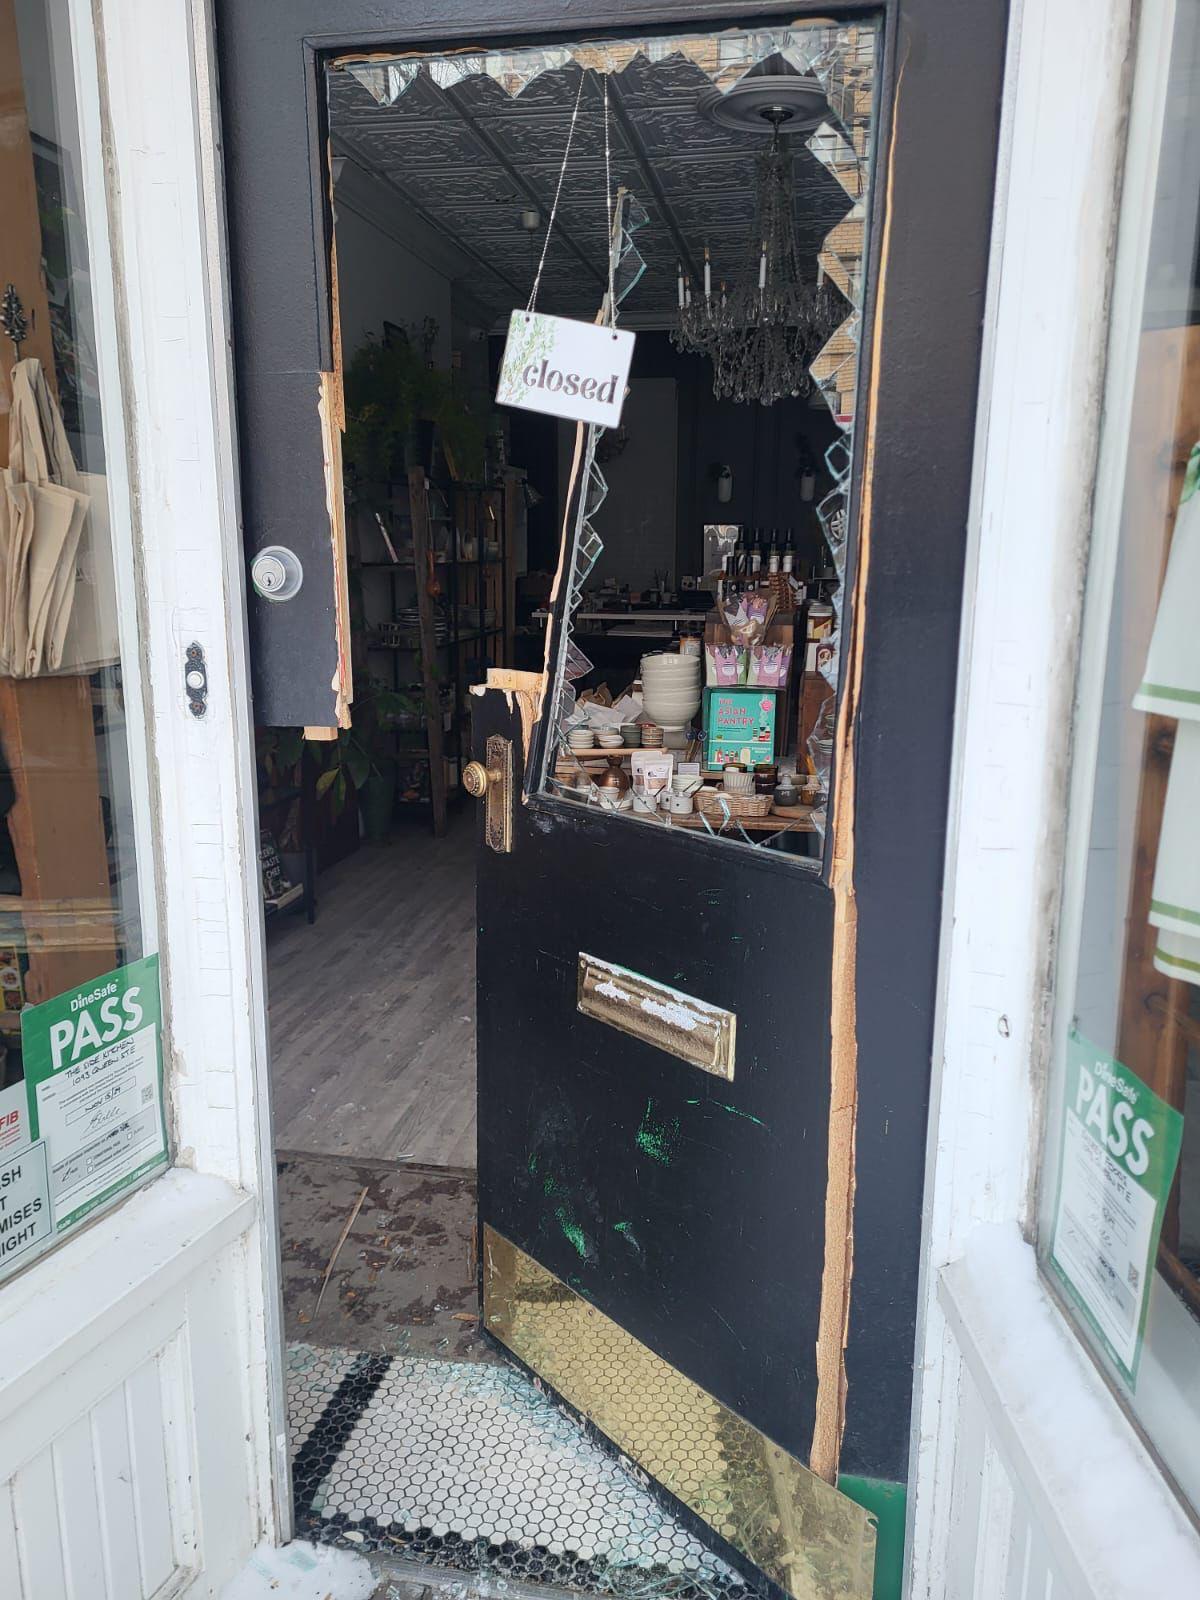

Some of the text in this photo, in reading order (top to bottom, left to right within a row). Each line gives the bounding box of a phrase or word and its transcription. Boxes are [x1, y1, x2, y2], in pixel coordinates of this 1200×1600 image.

[522, 358, 620, 404] closed
[717, 717, 755, 726] PANTRY
[70, 981, 117, 1012] DineSafe
[50, 986, 143, 1070] PASS
[65, 1066, 80, 1079] THE
[102, 1037, 135, 1060] KITCHEN
[1094, 1061, 1137, 1105] DineSafe
[1076, 1064, 1155, 1176] PASS
[0, 1165, 21, 1190] SH
[0, 1221, 36, 1259] IGHT
